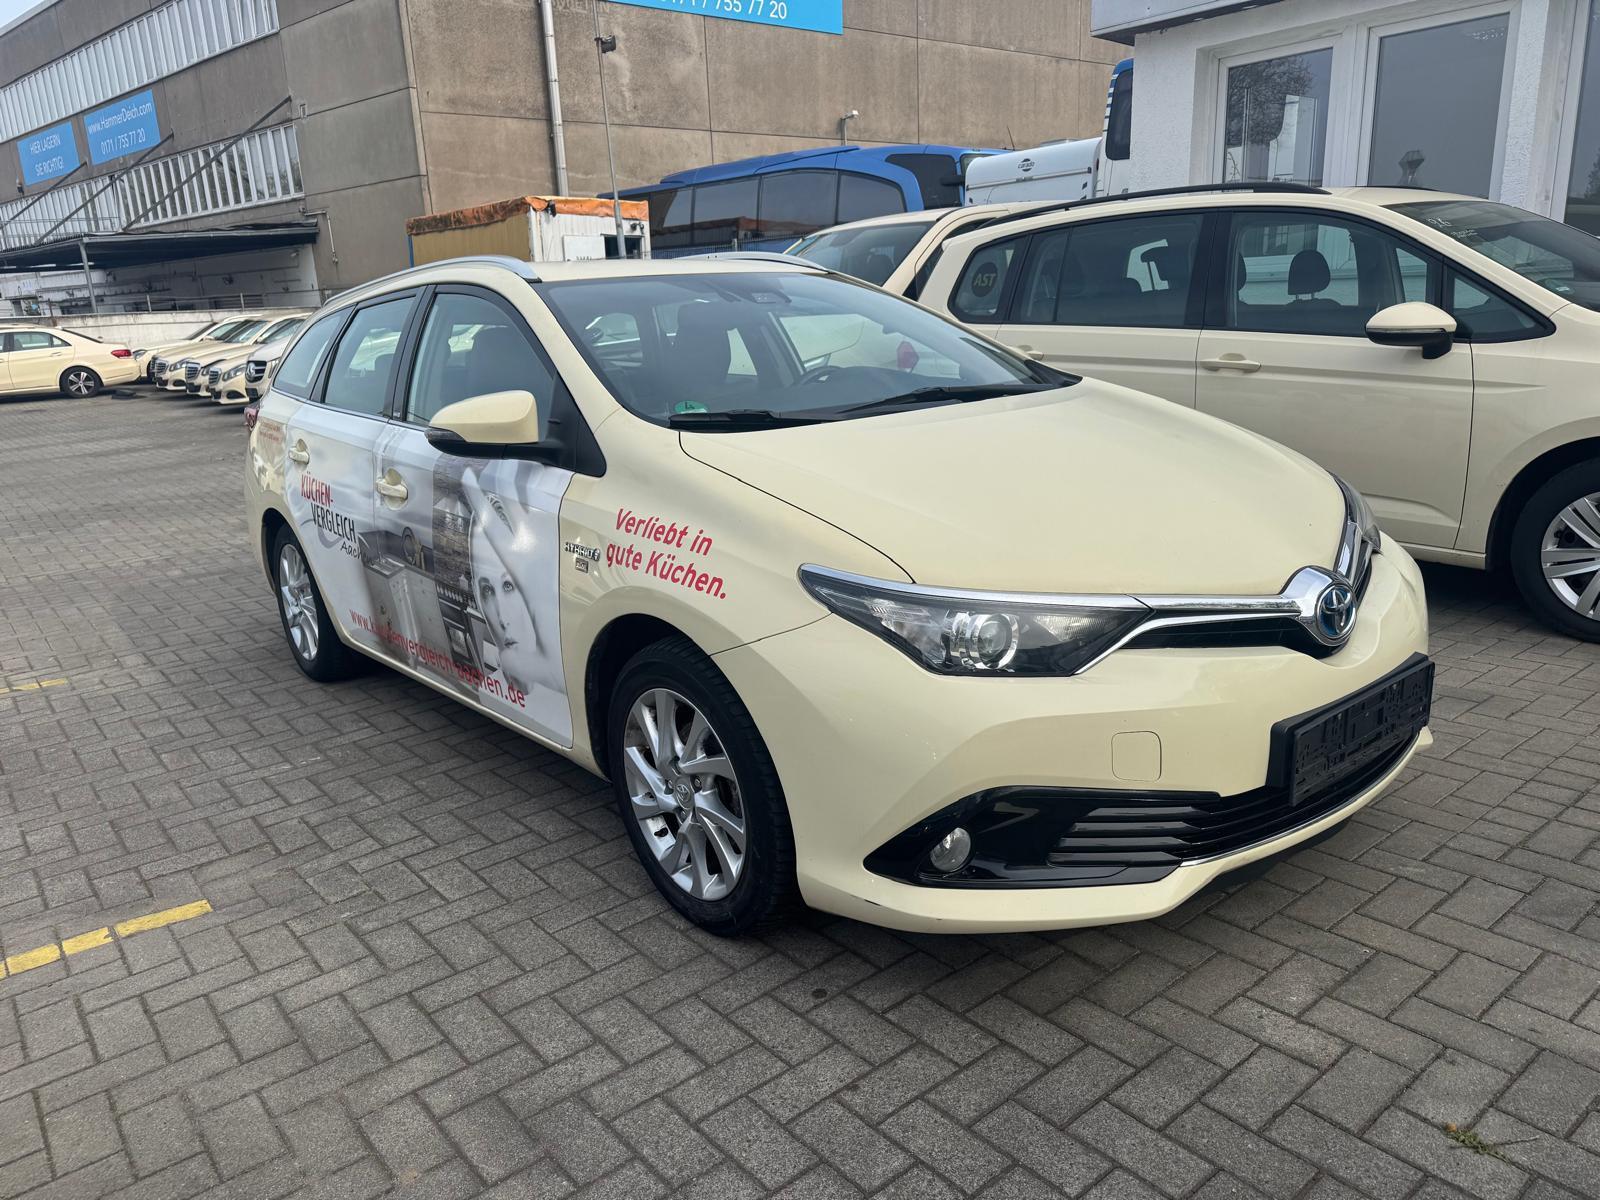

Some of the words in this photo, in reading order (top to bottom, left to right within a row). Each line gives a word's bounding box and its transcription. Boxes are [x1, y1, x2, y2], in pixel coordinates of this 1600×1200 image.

[748, 0, 763, 16] 77
[769, 0, 787, 19] 20
[118, 133, 130, 149] 755
[129, 130, 137, 146] 77
[137, 127, 146, 143] 20
[973, 272, 998, 287] AST
[301, 471, 334, 508] KÜCHEN-
[310, 502, 357, 544] VERGLEICH
[615, 508, 689, 548] Verliebt
[690, 529, 713, 556] in
[606, 542, 643, 571] gute
[645, 550, 727, 600] Küchen.
